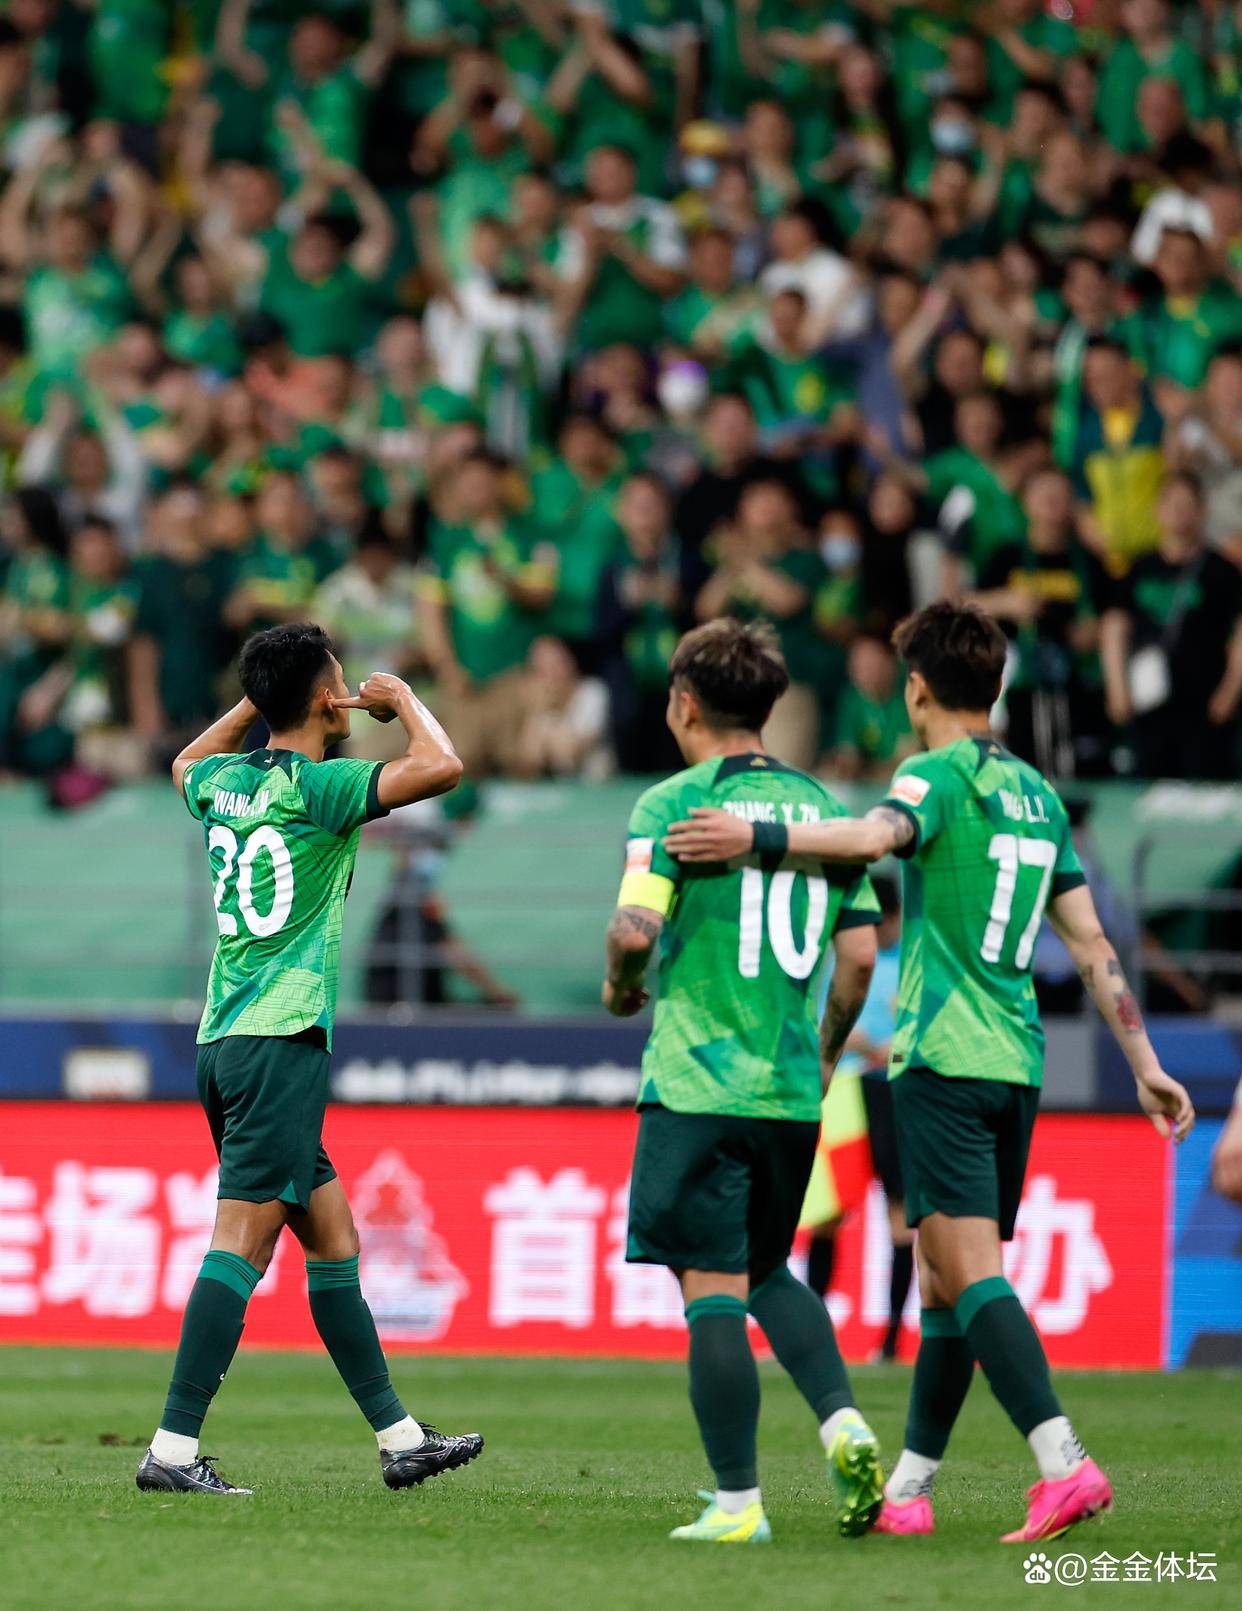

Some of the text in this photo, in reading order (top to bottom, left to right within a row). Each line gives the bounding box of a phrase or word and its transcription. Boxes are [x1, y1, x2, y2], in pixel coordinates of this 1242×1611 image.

[208, 825, 294, 937] 20
[738, 866, 828, 979] 10
[980, 833, 1057, 970] 17
